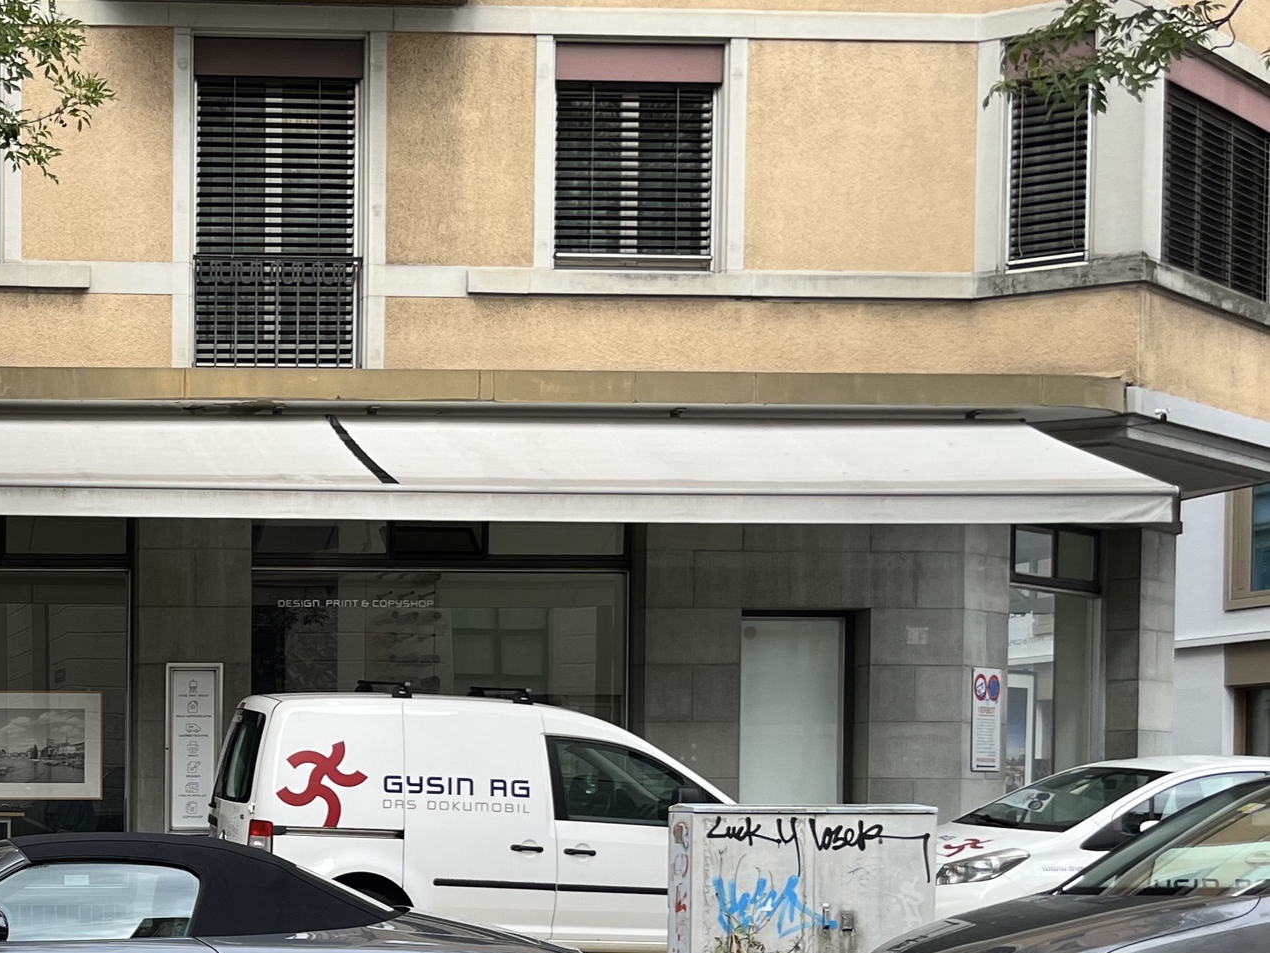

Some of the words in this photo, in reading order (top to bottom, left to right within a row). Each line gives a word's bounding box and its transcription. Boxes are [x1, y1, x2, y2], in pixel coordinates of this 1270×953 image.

[326, 599, 359, 608] PRINT
[372, 599, 434, 608] COPYSHOP
[383, 775, 474, 796] GYSIN
[490, 779, 530, 798] AG
[382, 799, 417, 810] DAS
[427, 801, 530, 813] DOKUMOBIL
